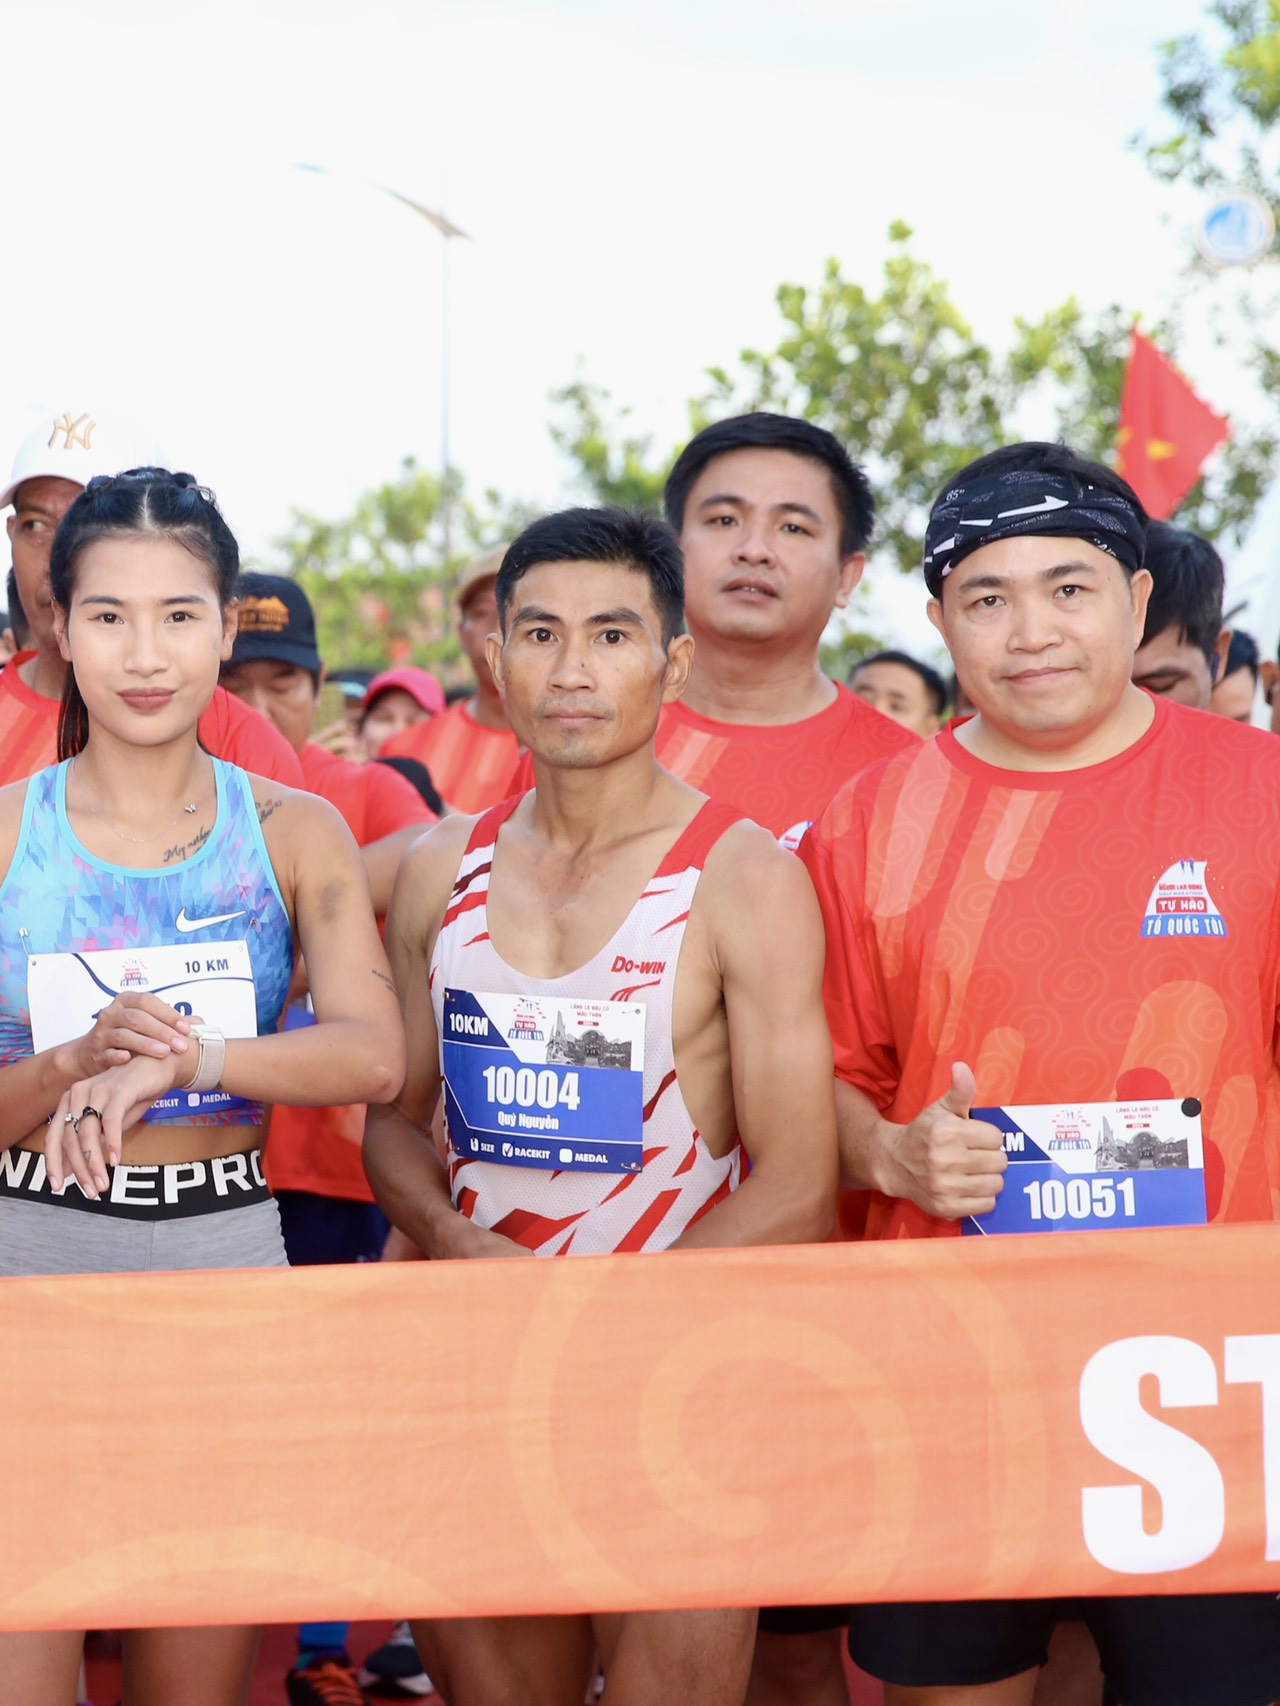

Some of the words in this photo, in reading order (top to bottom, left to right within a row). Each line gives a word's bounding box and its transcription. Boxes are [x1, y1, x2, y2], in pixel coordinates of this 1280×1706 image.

[185, 960, 201, 973] 10
[206, 959, 229, 971] KM
[449, 1013, 489, 1036] 10KM
[483, 1065, 580, 1110] 10004
[202, 1093, 231, 1104] MEDAL
[480, 1143, 495, 1153] SIZE
[514, 1148, 550, 1160] RACEKIT
[574, 1152, 608, 1163] MEDAL
[1023, 1177, 1136, 1220] 10051
